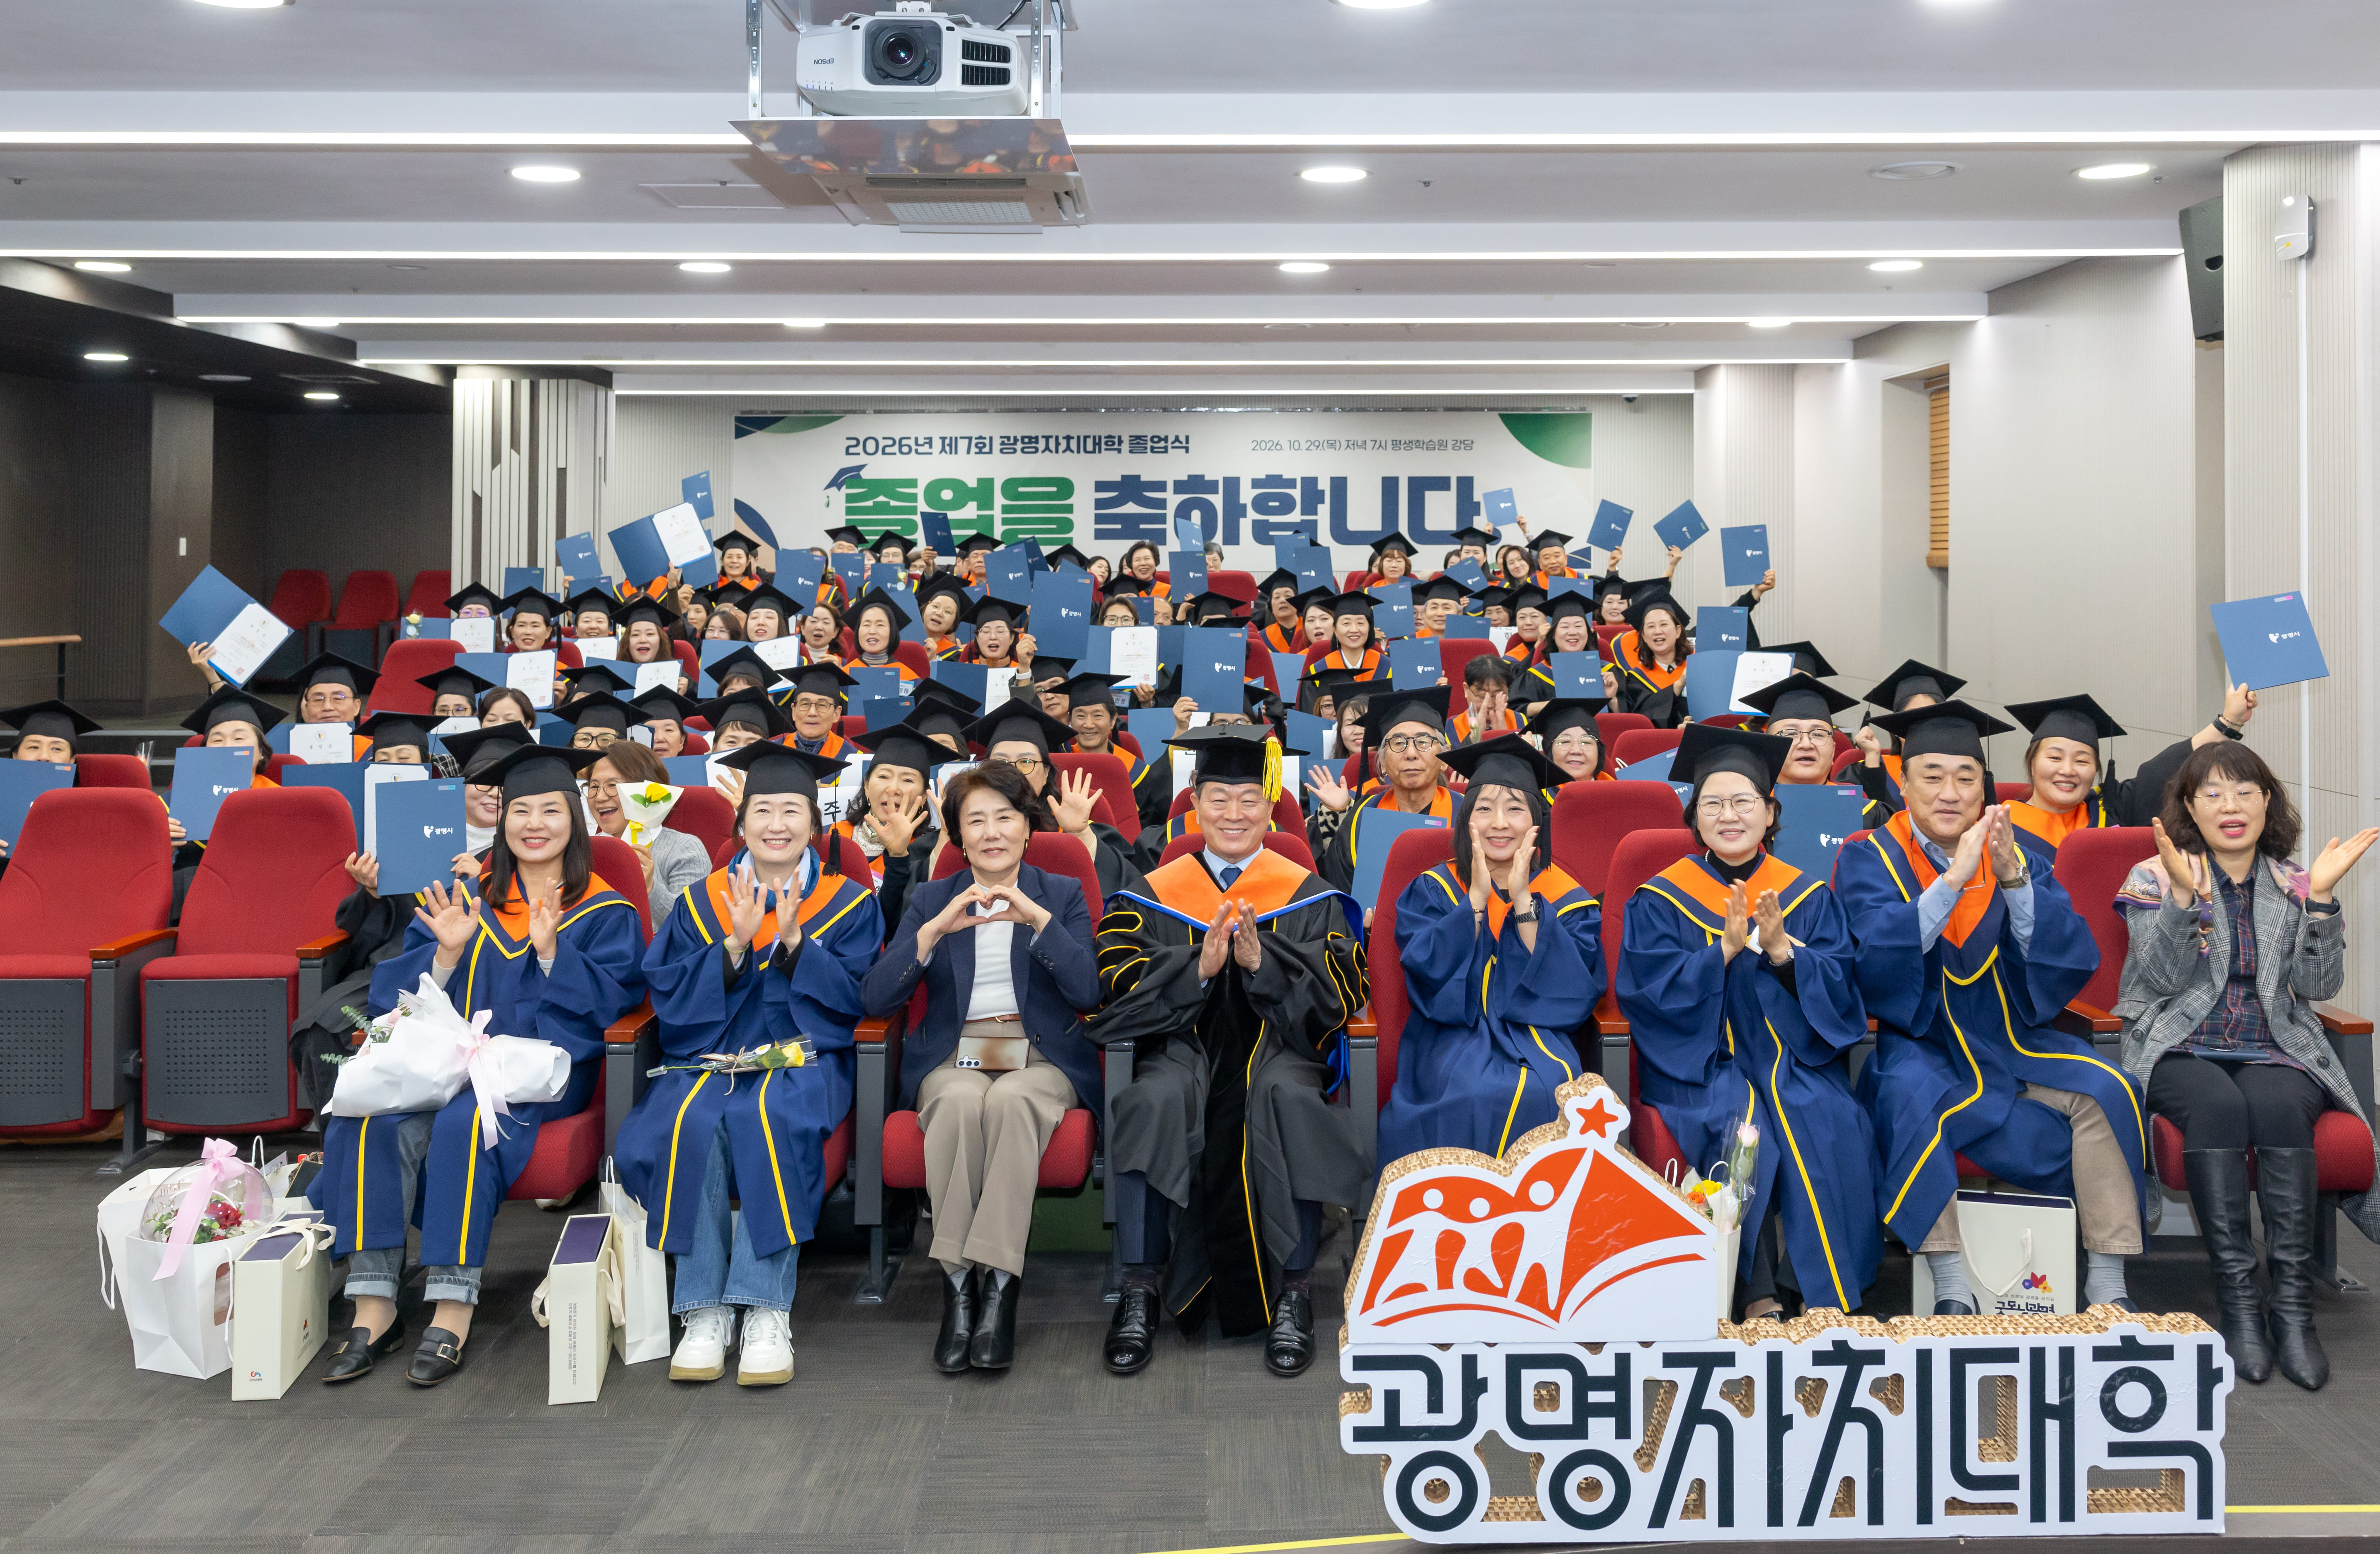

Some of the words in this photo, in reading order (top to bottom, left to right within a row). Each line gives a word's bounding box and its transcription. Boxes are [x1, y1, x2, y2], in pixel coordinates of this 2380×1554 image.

[845, 436, 933, 456] 2026년
[939, 435, 993, 455] 제7회
[999, 435, 1124, 454] 광명자치대학
[1128, 435, 1190, 454] 졸업식
[1251, 440, 1284, 451] 2026.
[1288, 440, 1302, 451] 10.
[1305, 439, 1341, 451] 29.(목)
[1344, 439, 1367, 451] 저녁
[1370, 439, 1387, 450] 7시
[1391, 439, 1448, 451] 평생학습원
[1452, 439, 1475, 451] 강당
[845, 477, 1074, 548] 졸업을
[2281, 631, 2300, 640] 광명시
[1353, 1335, 2224, 1532] 광명자치대학
